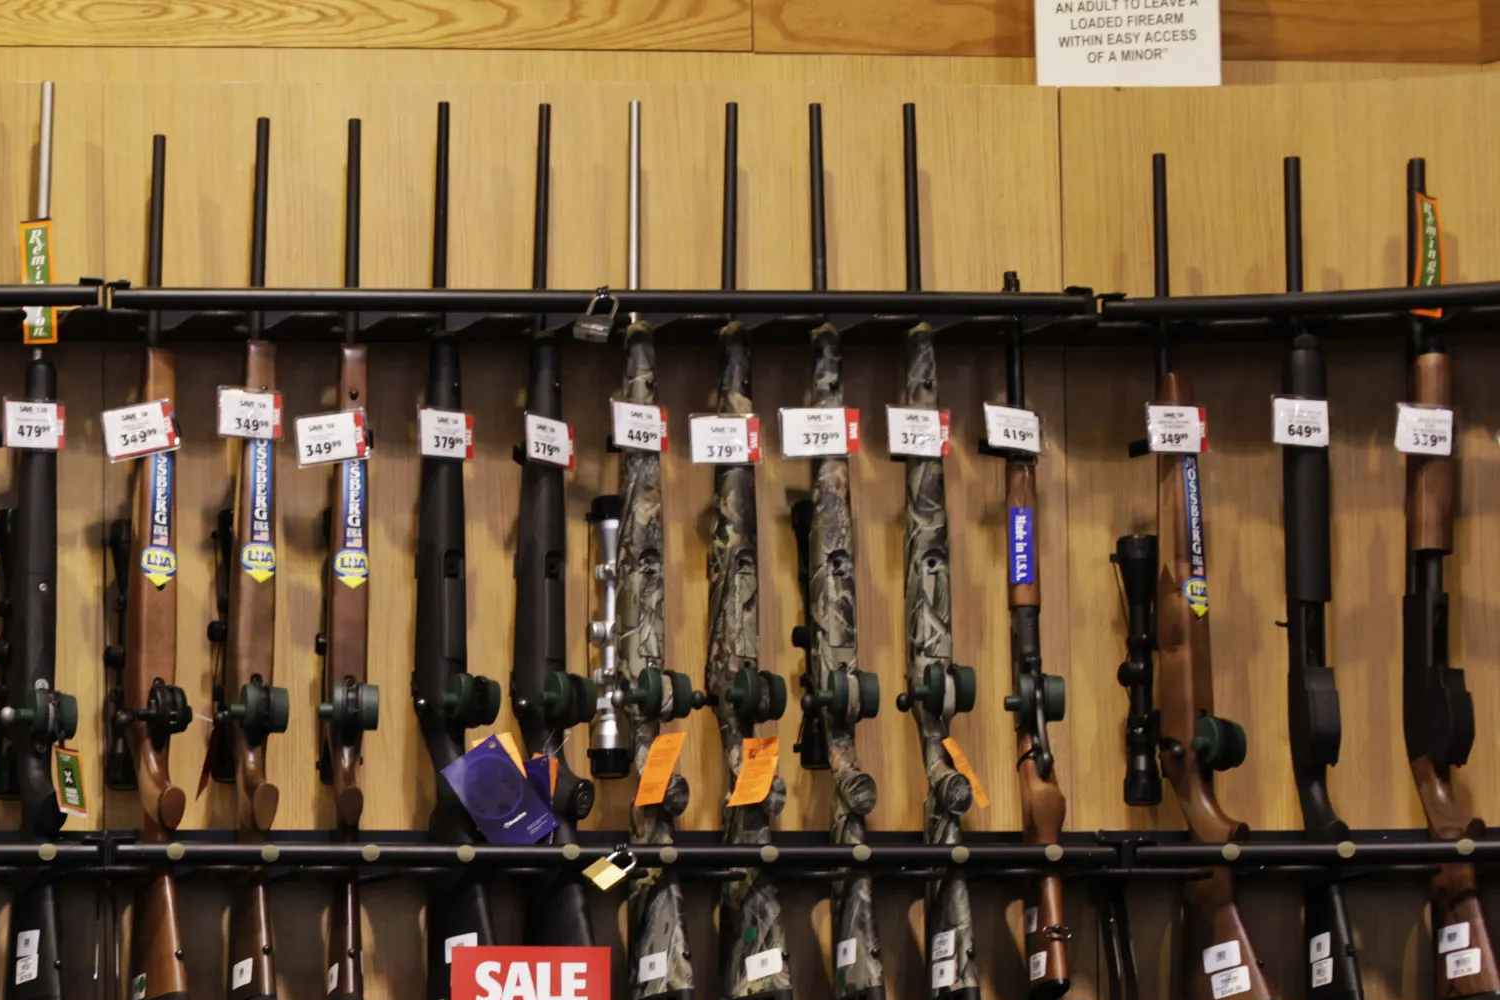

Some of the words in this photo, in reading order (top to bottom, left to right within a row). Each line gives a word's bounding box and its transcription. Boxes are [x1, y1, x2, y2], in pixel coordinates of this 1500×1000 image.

[1055, 2, 1073, 14] AN
[1077, 0, 1118, 13] ADULT
[1124, 0, 1140, 10] TO
[1070, 16, 1123, 31] LOADED
[1127, 12, 1184, 26] FIREARM
[1058, 34, 1103, 48] WITHIN
[1107, 32, 1141, 45] EASY
[1145, 29, 1197, 43] ACCESS
[1087, 52, 1104, 64] OF
[1108, 51, 1118, 62] A
[255, 438, 268, 520] OSSBERG
[1014, 515, 1028, 538] Made
[1016, 541, 1026, 552] in
